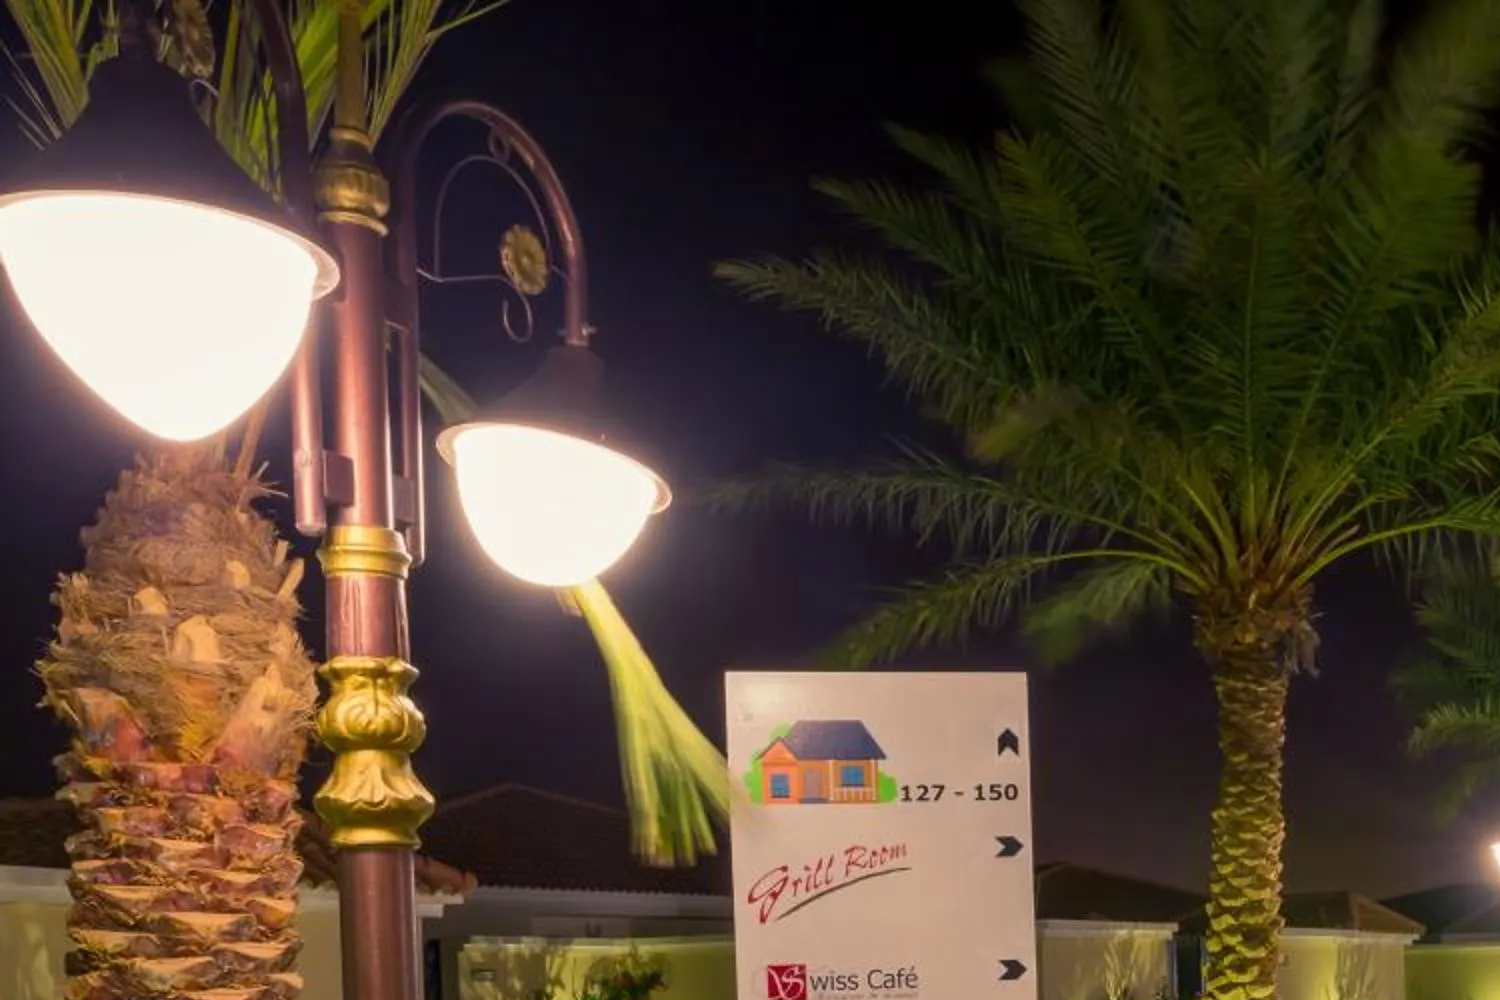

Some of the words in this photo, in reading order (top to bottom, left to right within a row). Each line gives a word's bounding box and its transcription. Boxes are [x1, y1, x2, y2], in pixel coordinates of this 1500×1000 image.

[900, 783, 945, 802] 127
[975, 783, 1019, 801] 150
[748, 853, 834, 924] Grill
[843, 843, 908, 878] Room
[866, 966, 918, 990] Café
